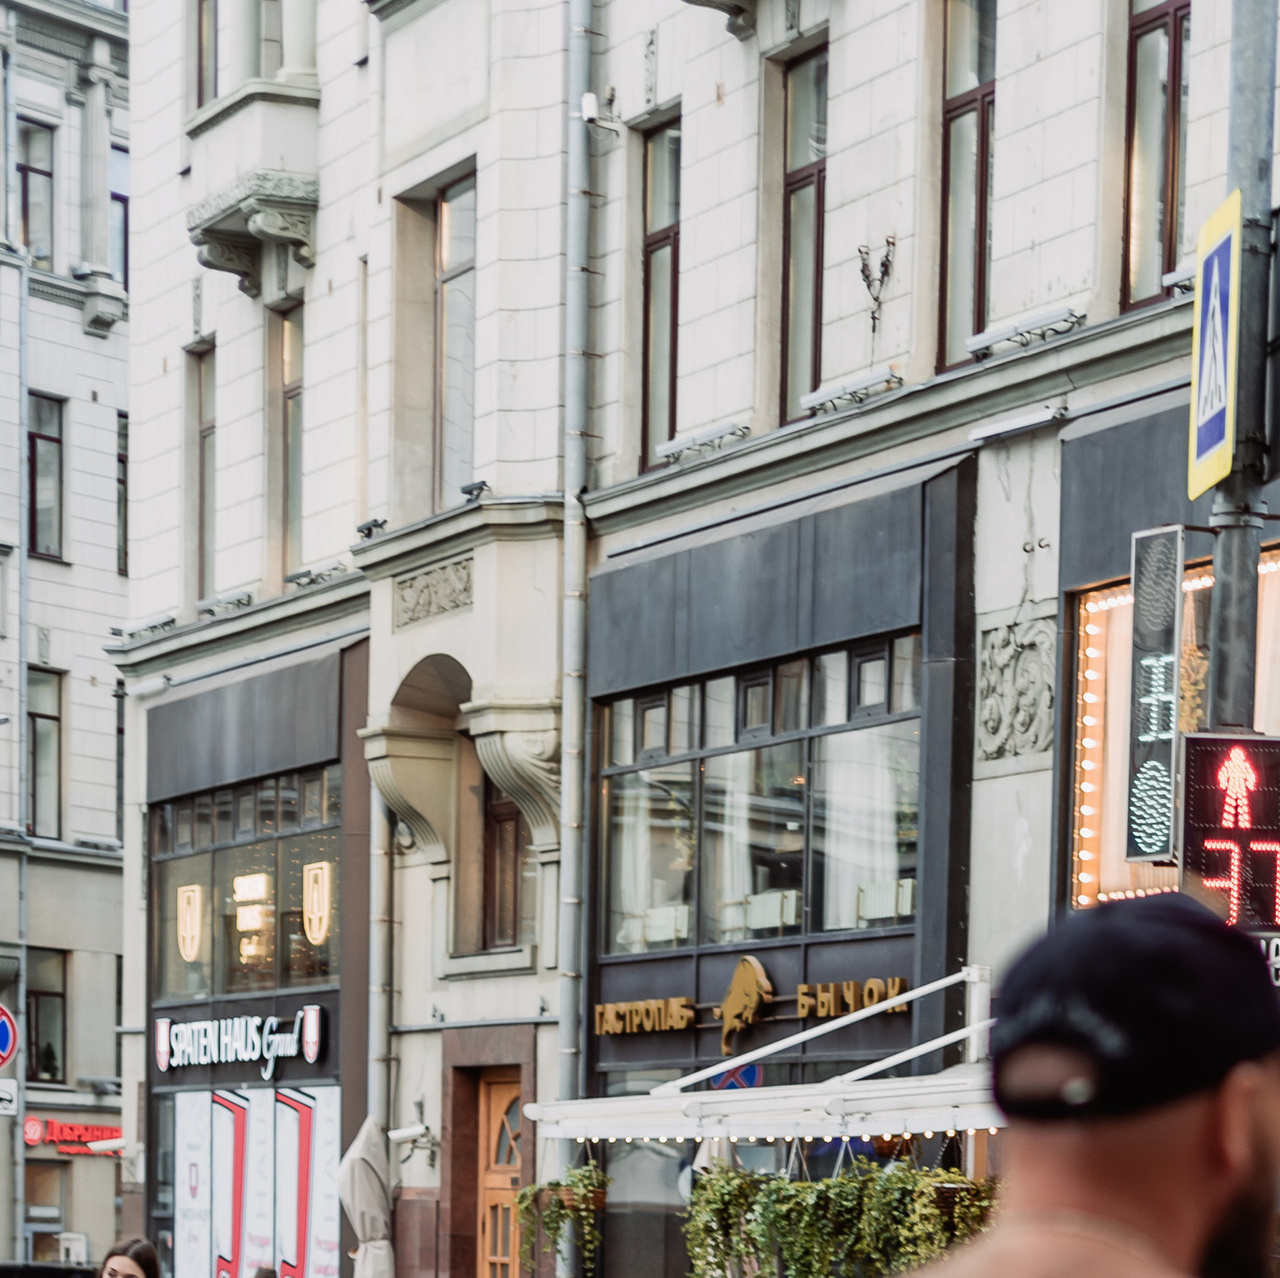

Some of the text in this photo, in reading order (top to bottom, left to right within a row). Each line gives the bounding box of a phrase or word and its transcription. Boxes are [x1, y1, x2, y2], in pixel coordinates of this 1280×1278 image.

[594, 977, 907, 1035] ГАСТРОПАБ БЫЧОК
[170, 1019, 219, 1067] SPATEN
[220, 1016, 262, 1063] HAUS
